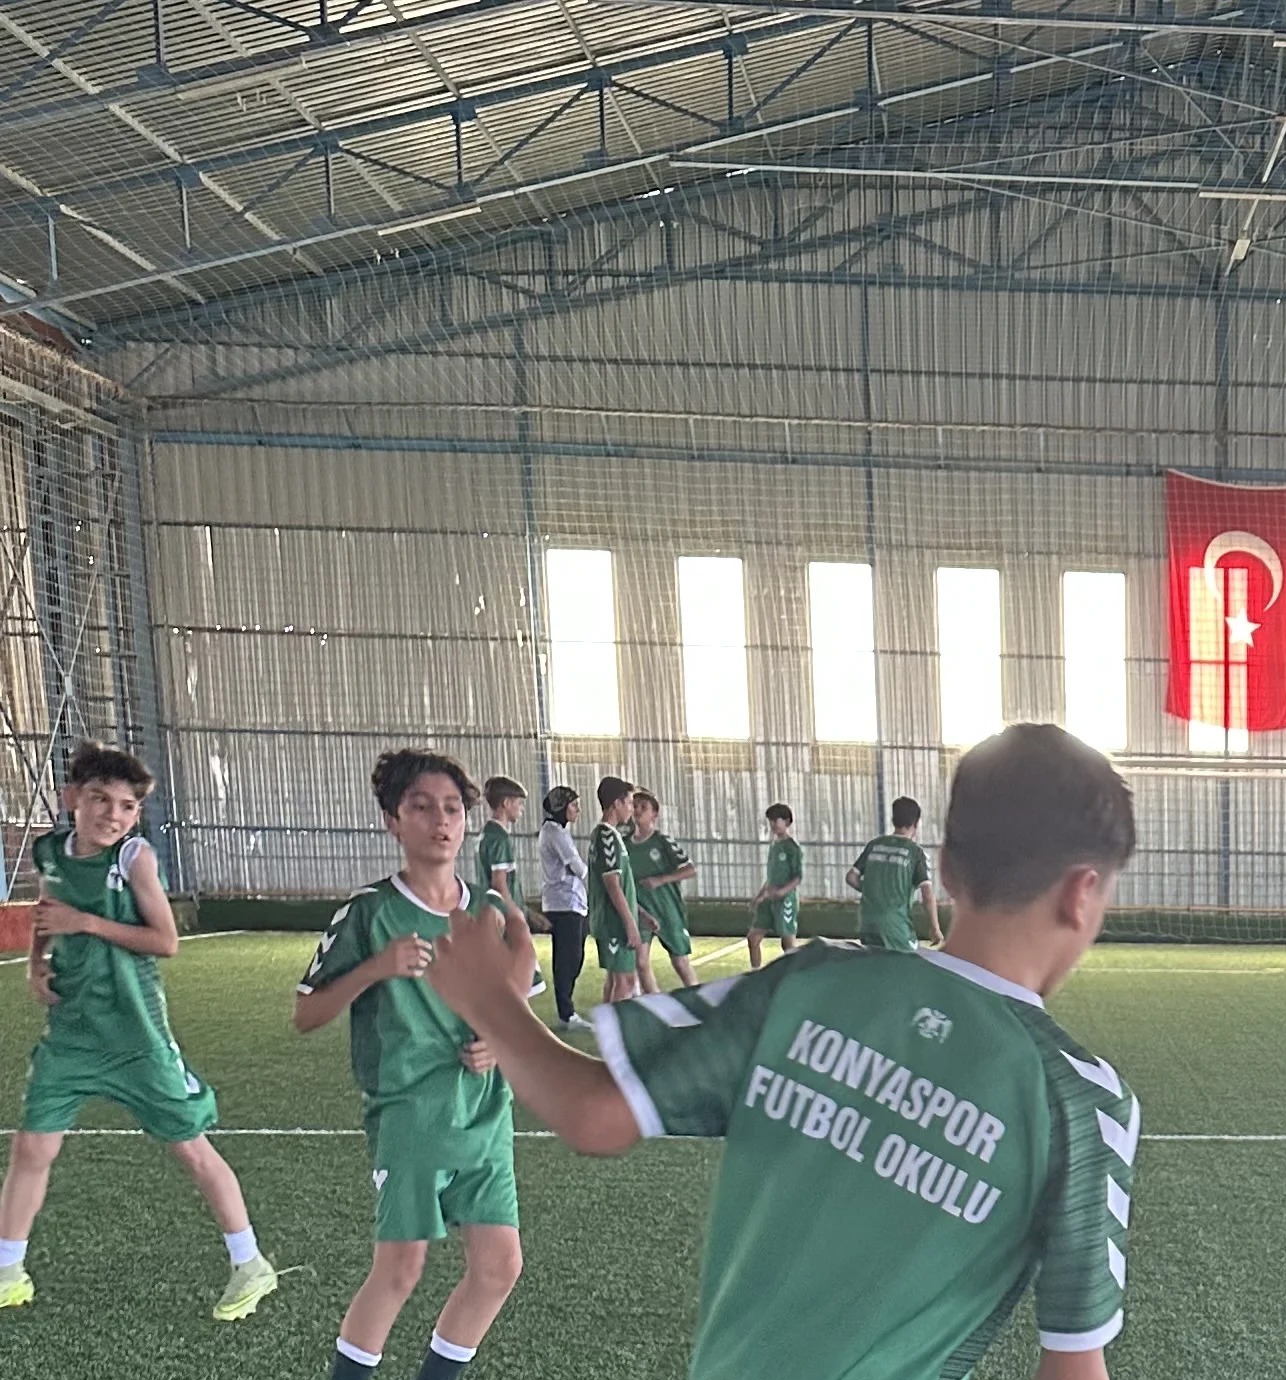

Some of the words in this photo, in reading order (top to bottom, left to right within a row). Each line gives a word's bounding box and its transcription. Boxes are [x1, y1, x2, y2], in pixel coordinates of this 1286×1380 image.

[744, 1064, 873, 1163] FUTBOL
[874, 1132, 1003, 1225] OKULU
[786, 1019, 1006, 1164] KONYASPOR
